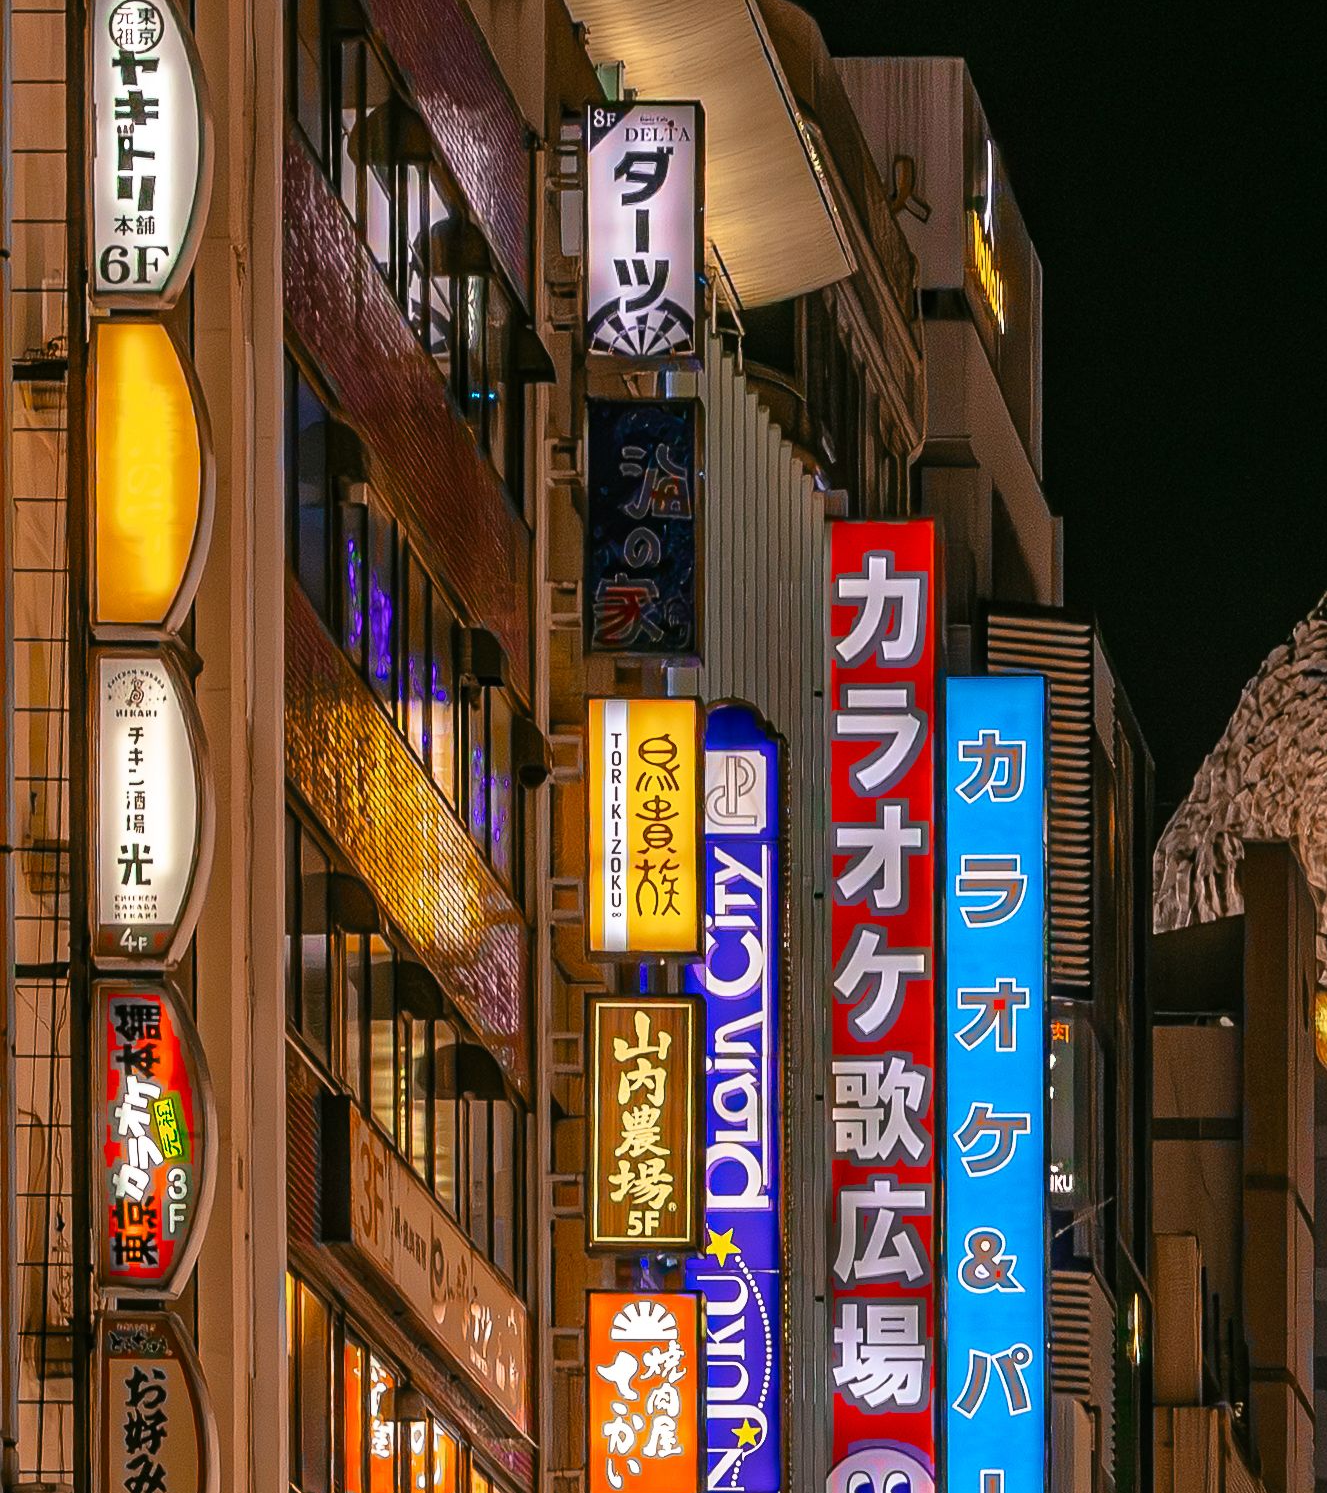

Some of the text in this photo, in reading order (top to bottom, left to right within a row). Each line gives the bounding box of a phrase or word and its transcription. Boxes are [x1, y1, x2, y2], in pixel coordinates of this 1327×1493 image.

[593, 108, 617, 129] 8F
[624, 126, 692, 143] DELTA
[113, 214, 156, 237] 本舗
[613, 144, 675, 314] ダーツ
[99, 246, 170, 286] 6F
[609, 732, 623, 905] TORIKIZOKU
[118, 843, 154, 886] 光
[119, 928, 148, 952] 4F
[834, 553, 929, 1408] カラオケ歌広場
[608, 1010, 676, 1210] 山内農場
[167, 1166, 188, 1235] 3F
[626, 1210, 661, 1237] 5F
[640, 1340, 686, 1460] 焼肉屋
